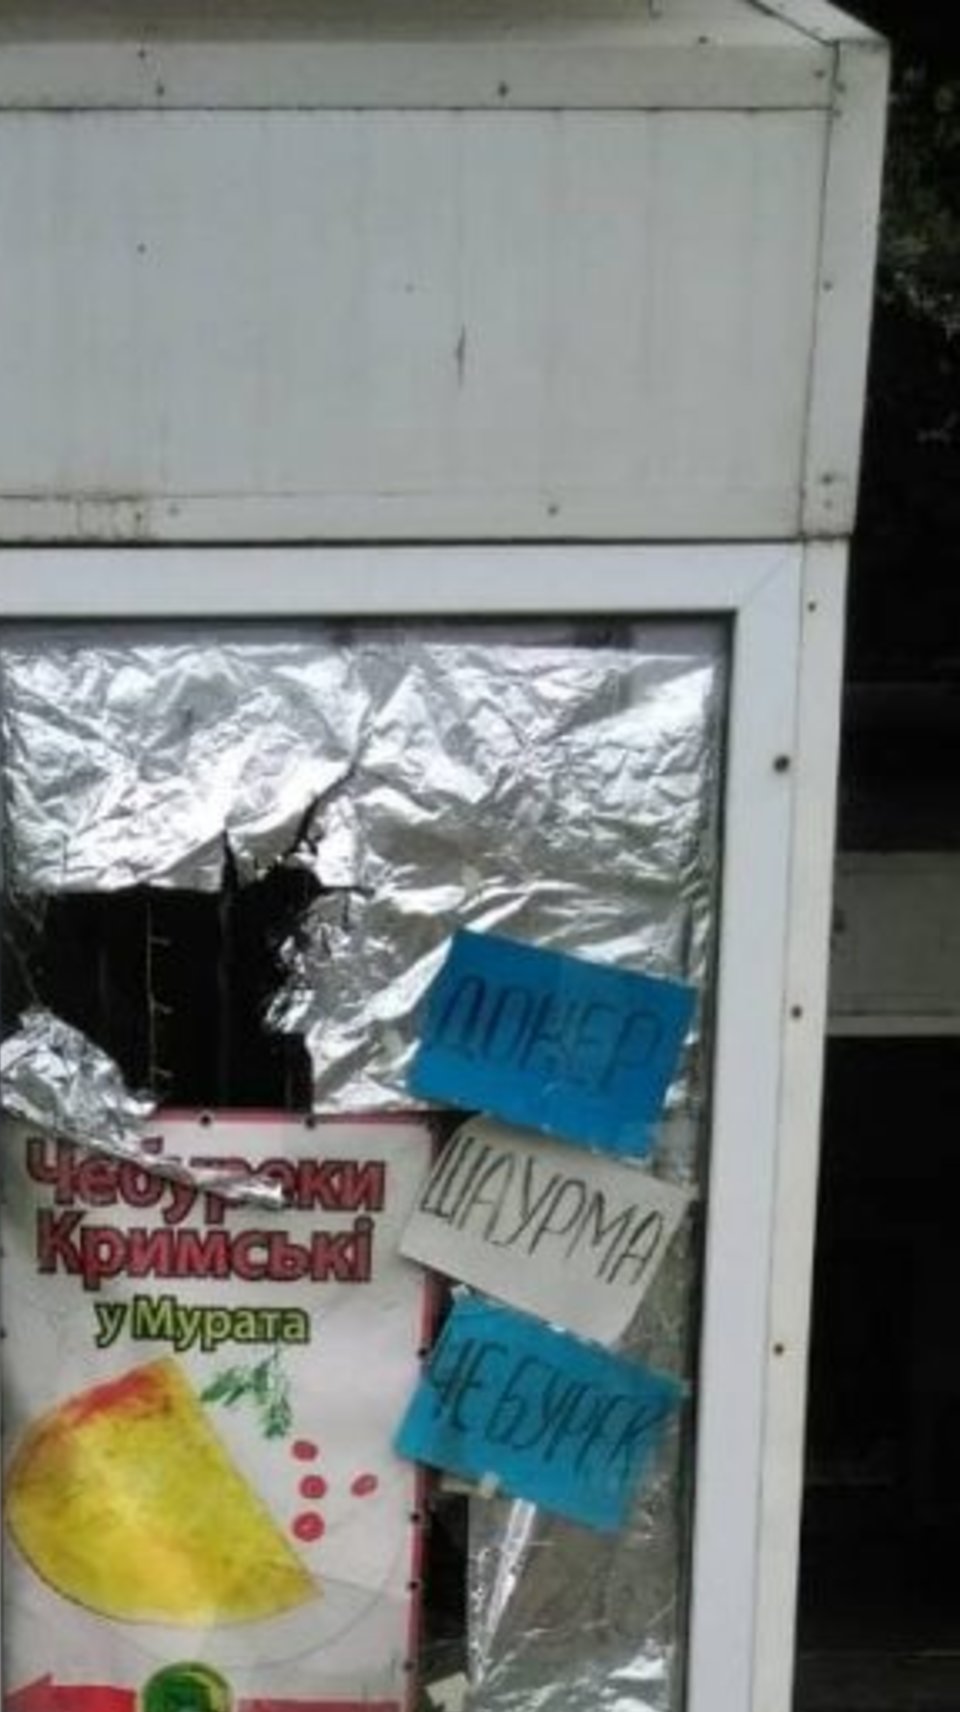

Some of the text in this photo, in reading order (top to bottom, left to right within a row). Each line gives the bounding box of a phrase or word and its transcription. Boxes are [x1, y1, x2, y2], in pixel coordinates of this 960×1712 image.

[36, 1206, 375, 1291] Кримські
[421, 1134, 670, 1287] ШАУРМА
[94, 1294, 311, 1352] у Мурата
